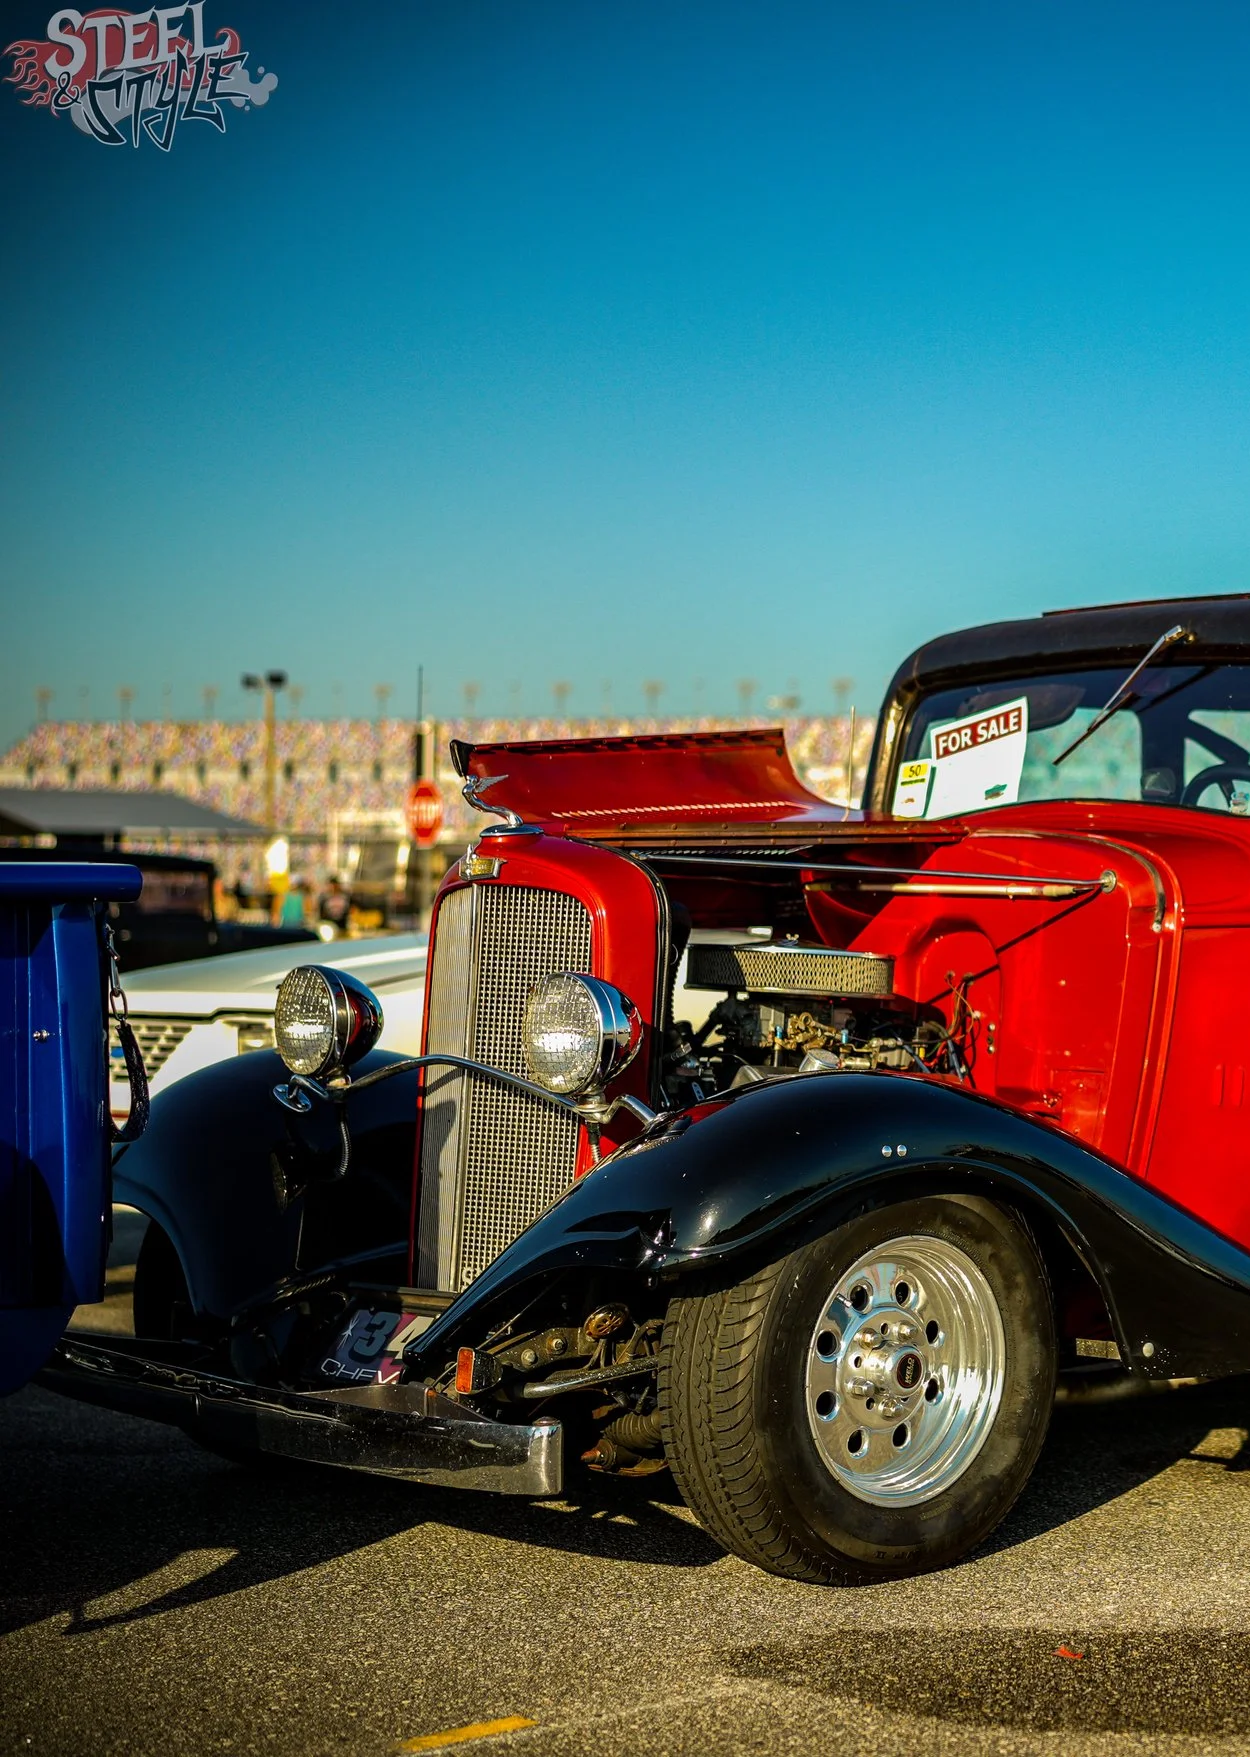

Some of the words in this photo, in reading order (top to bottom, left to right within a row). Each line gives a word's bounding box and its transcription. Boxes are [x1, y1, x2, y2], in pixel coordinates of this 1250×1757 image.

[938, 730, 973, 756] FOR
[977, 711, 1020, 742] SALE
[320, 1357, 401, 1384] CHEV
